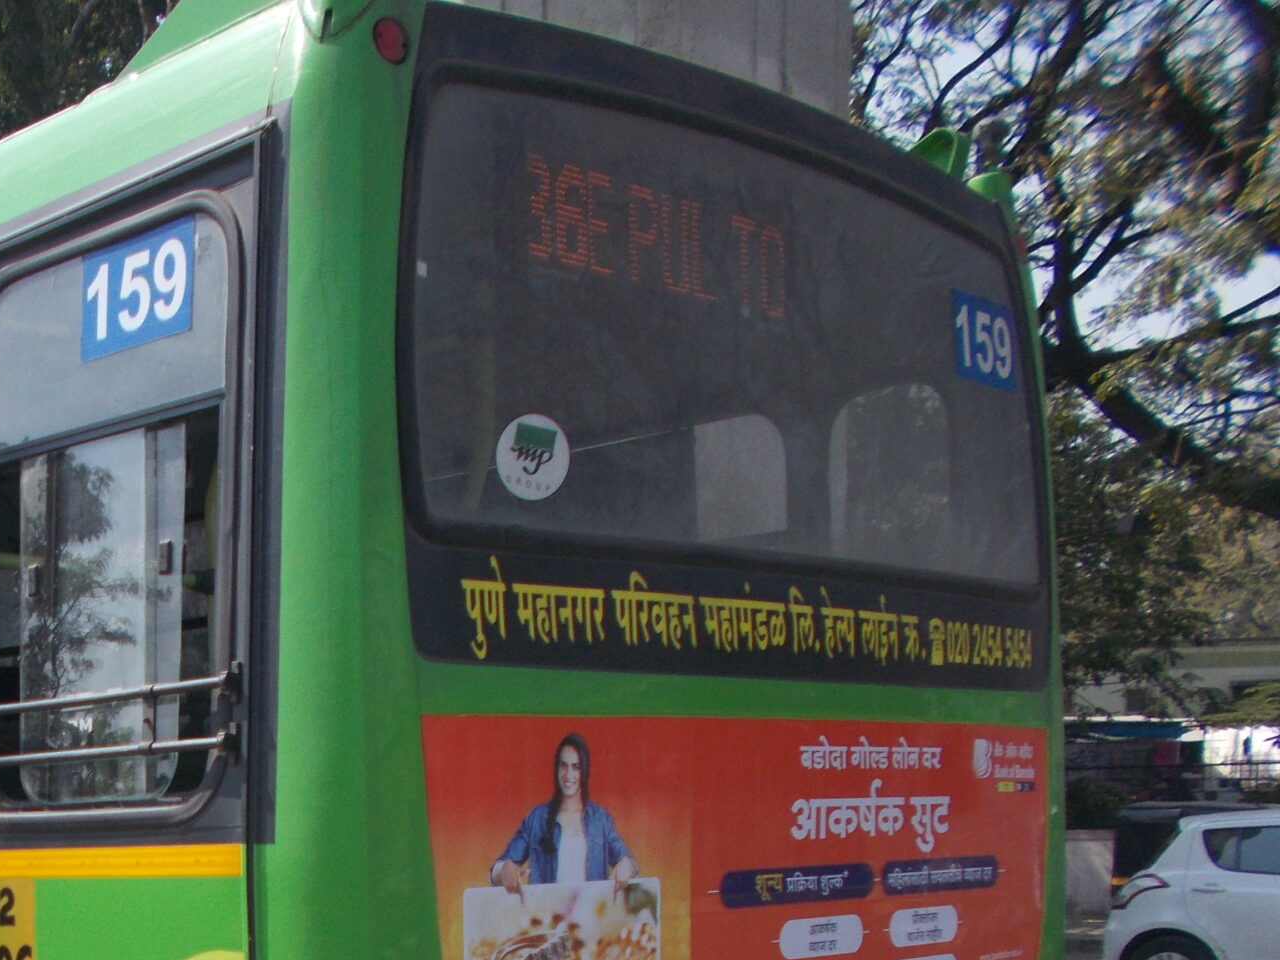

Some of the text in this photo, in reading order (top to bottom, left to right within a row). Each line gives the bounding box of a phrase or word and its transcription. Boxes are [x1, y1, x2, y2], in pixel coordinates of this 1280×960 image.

[87, 238, 187, 342] 159
[955, 304, 1012, 379] 159
[460, 555, 506, 660] पुणे
[512, 583, 606, 644] महानगर
[611, 570, 698, 650] परिवहन
[699, 582, 786, 653] महामंडळ
[821, 586, 856, 659] हेल्प
[947, 620, 970, 665] 020
[972, 623, 1003, 668] 2454
[1005, 626, 1033, 669] 5454
[799, 735, 942, 770] बडोदा गोल्ड लोन वर
[791, 778, 951, 853] आकर्षक सुट
